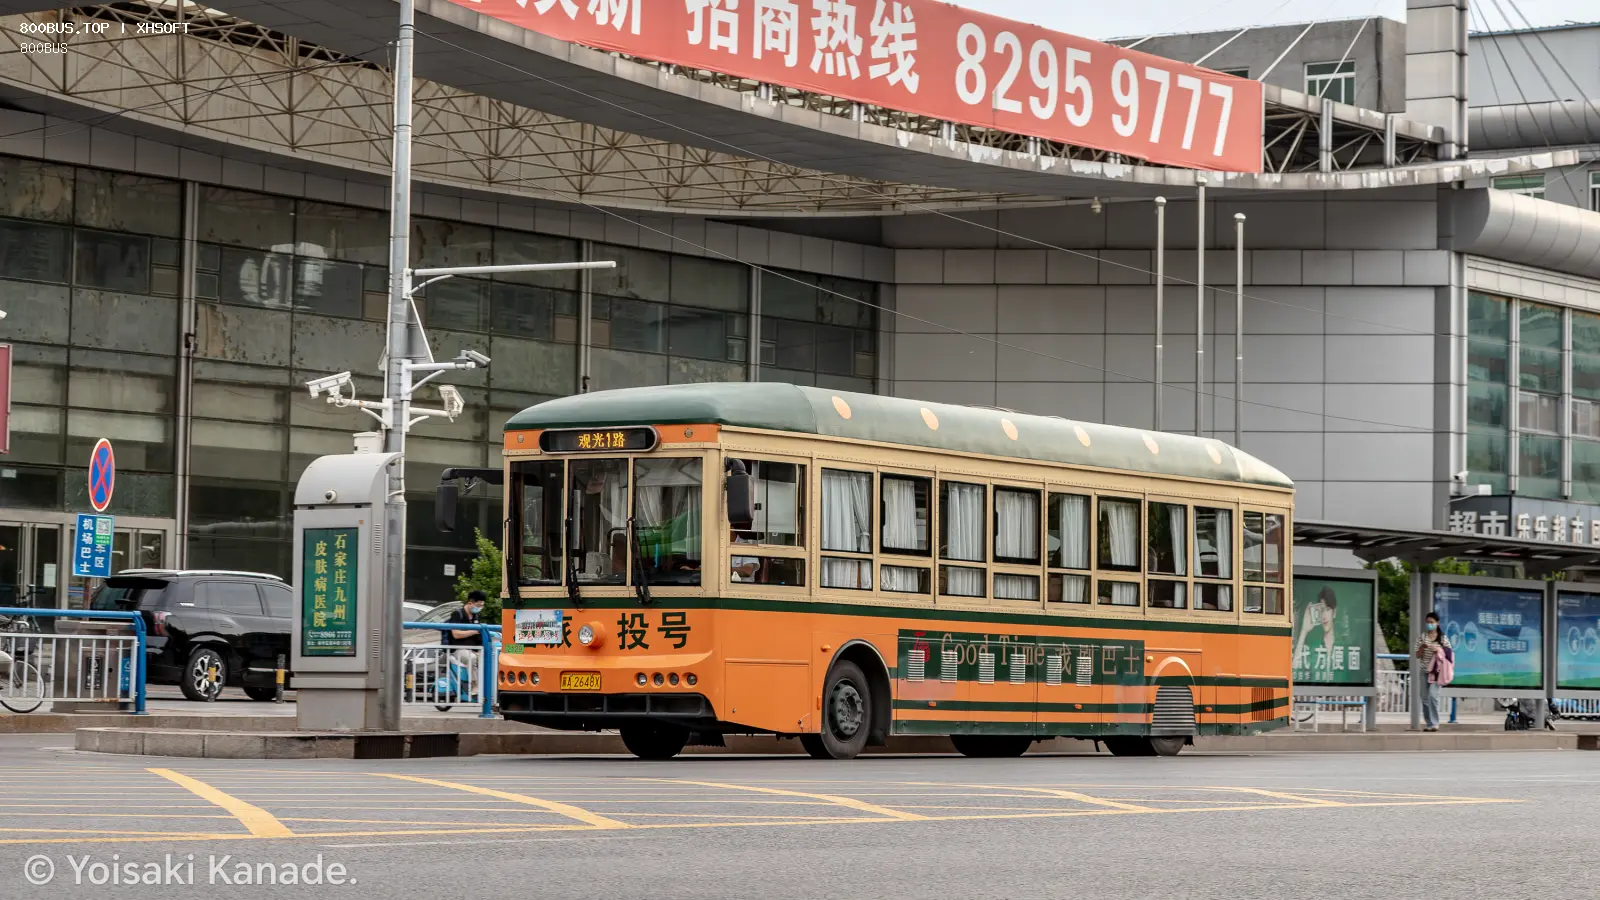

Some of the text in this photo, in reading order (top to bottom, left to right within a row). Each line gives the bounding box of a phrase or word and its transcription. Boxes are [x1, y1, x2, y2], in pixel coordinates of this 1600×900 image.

[687, 0, 1233, 157] 招商热线 8295 9777
[578, 431, 626, 449] 观光1路
[80, 517, 94, 573] 机场巴士
[1449, 510, 1508, 537] 超市
[313, 540, 328, 628] 皮肤病医院
[334, 533, 348, 620] 石家庄九州
